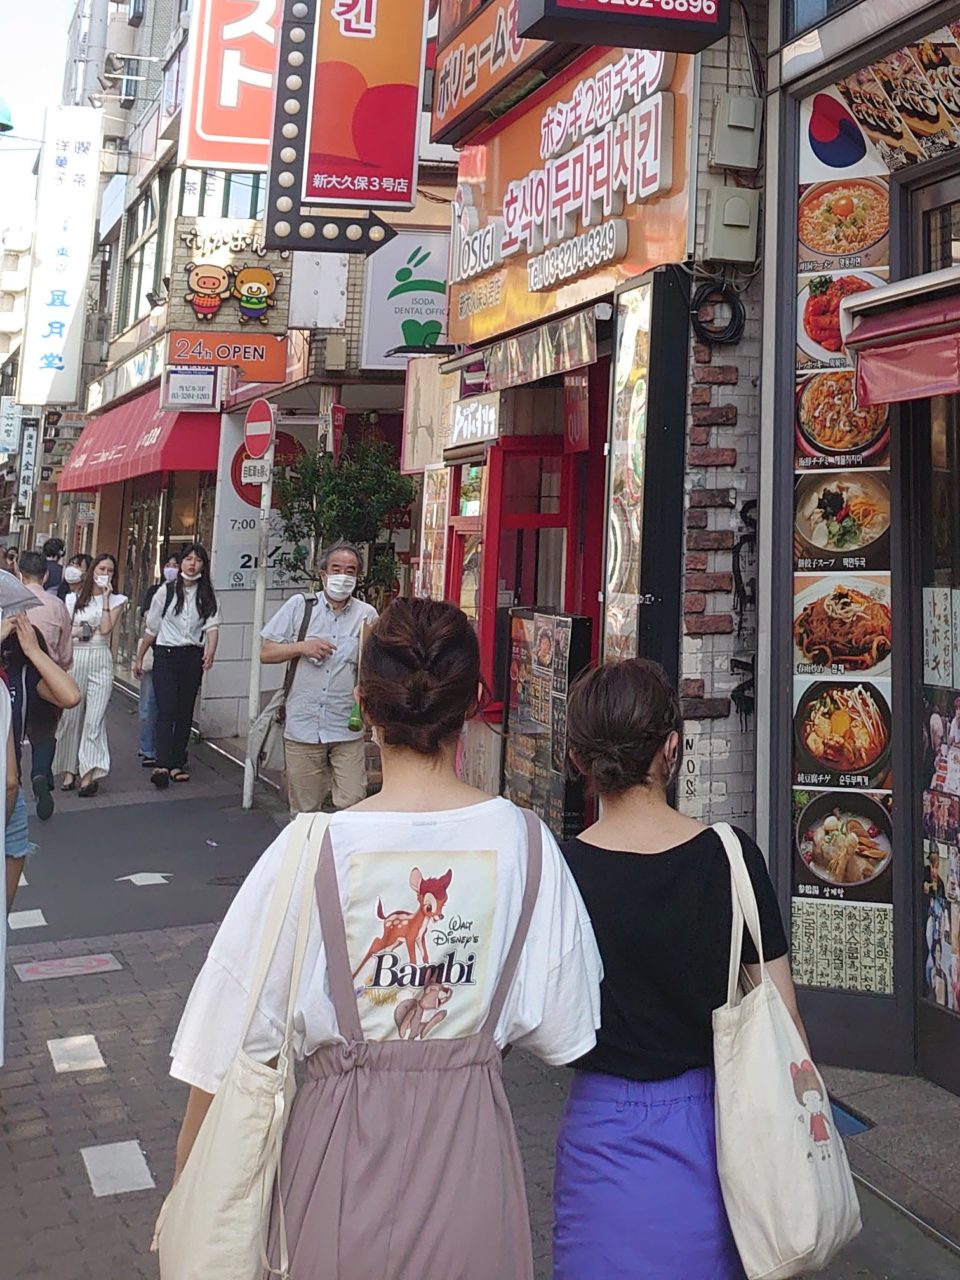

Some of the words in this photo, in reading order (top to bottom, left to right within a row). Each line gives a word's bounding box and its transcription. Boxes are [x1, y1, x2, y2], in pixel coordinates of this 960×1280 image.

[312, 171, 410, 195] 新大久保3号店
[501, 97, 662, 256] 호식이두마리치킨
[411, 297, 435, 306] ISODA
[394, 306, 423, 316] DENTAL
[424, 307, 447, 316] OFFIC
[216, 344, 266, 360] OPEN
[230, 519, 256, 530] 7:00
[365, 950, 477, 989] Bambi
